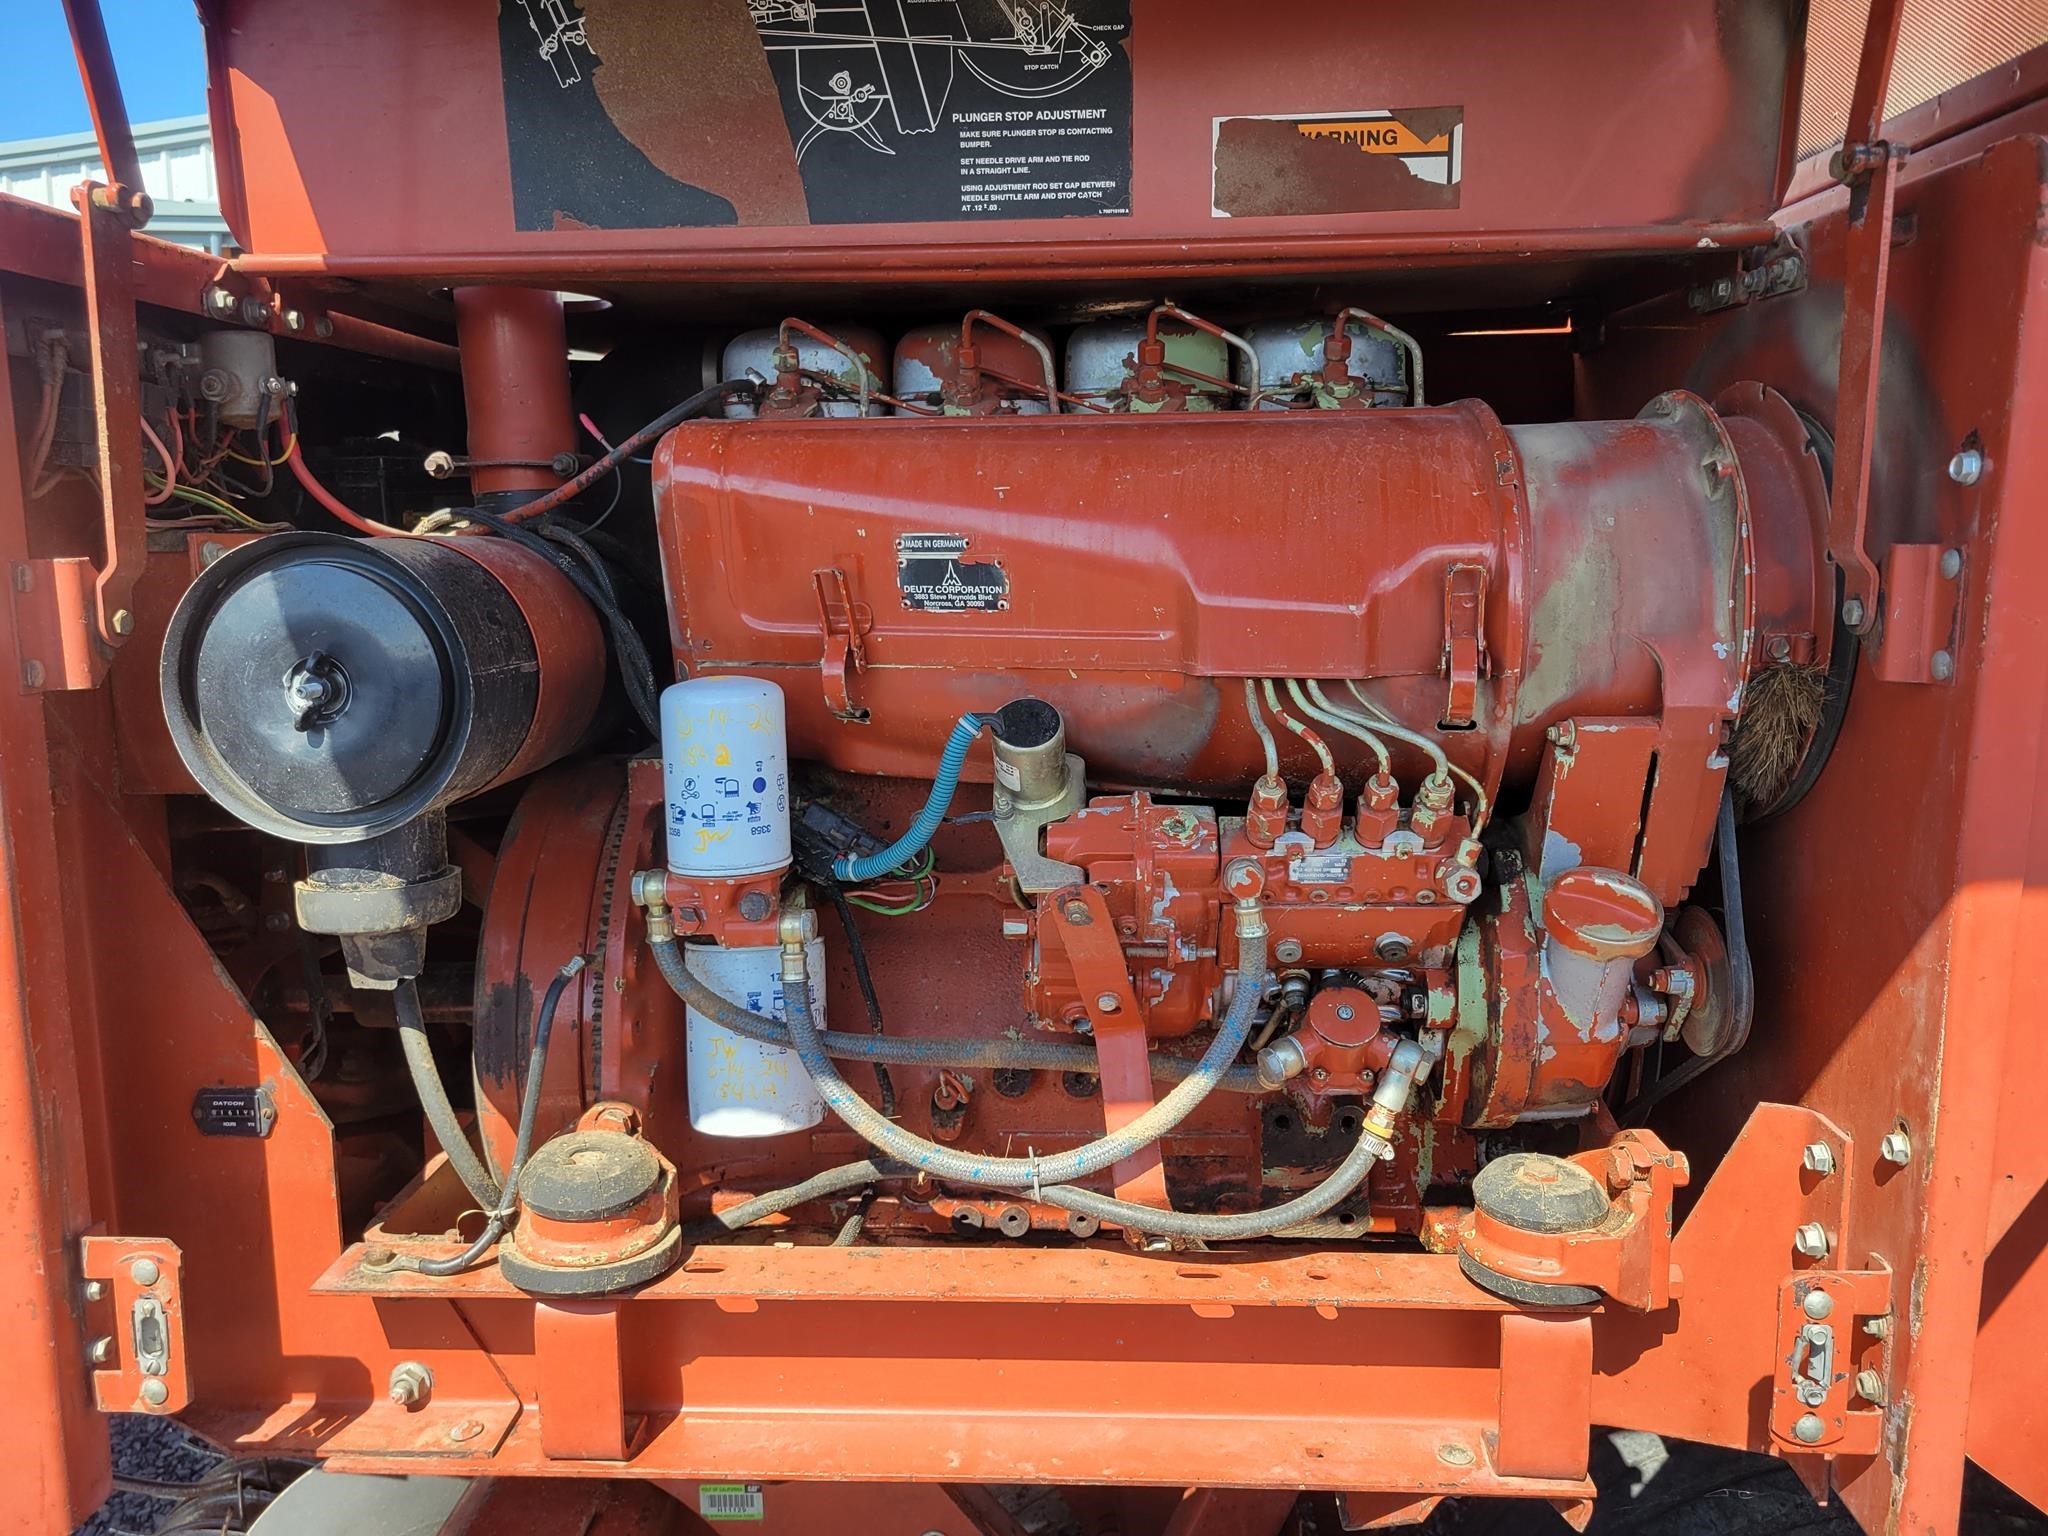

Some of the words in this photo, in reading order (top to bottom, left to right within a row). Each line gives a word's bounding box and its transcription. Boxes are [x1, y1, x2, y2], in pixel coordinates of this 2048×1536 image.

[952, 112, 1002, 123] PLUNGER
[1005, 111, 1033, 121] STOP
[1036, 109, 1106, 120] ADJUSTMENT
[982, 130, 1001, 138] SURE
[1003, 129, 1036, 137] PLUNGER
[1067, 127, 1113, 135] CONTACTING
[1301, 129, 1397, 145] RNING
[1005, 156, 1026, 164] DRIVE
[976, 167, 1011, 175] STRAIGHT
[906, 540, 922, 548] MADE
[924, 540, 931, 548] IN
[933, 539, 963, 548] GERMANY
[935, 585, 1002, 594] CORPORATION
